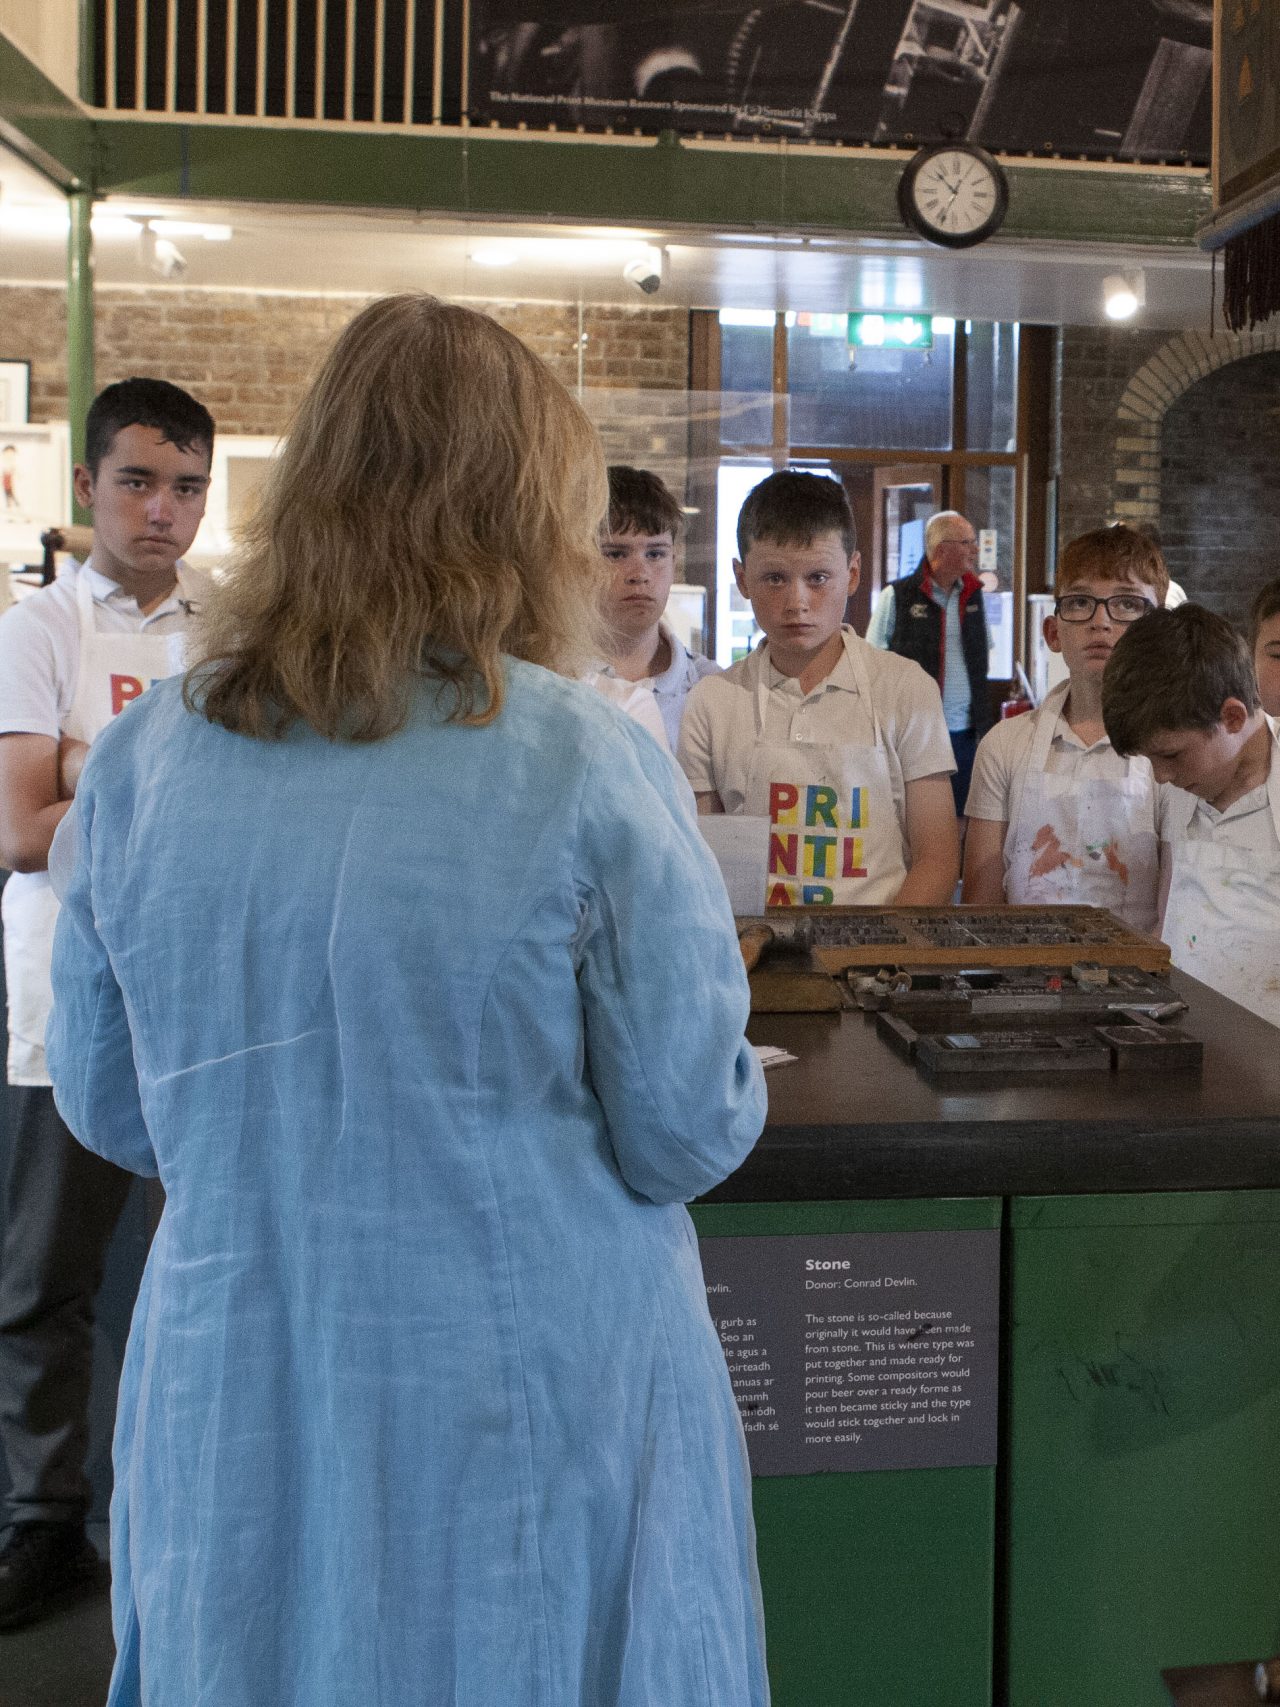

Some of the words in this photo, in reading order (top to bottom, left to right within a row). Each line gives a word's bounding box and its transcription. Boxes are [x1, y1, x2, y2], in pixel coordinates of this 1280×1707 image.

[489, 90, 509, 102] The
[511, 92, 555, 104] National
[557, 94, 582, 105] Print
[583, 96, 628, 108] Museum
[629, 98, 672, 109] Banners
[672, 100, 729, 114] Sponsored
[762, 105, 800, 118] Smurfit
[769, 782, 869, 829] PRI
[768, 832, 868, 878] NTL
[805, 1259, 851, 1271] Stone
[706, 1283, 732, 1293] evlin.
[805, 1280, 841, 1290] Donor:
[844, 1278, 881, 1289] Conrad
[885, 1277, 918, 1287] Devlin.
[806, 1314, 824, 1323] The
[827, 1314, 854, 1323] stone
[858, 1314, 864, 1322] is
[868, 1311, 911, 1321] so-called
[914, 1310, 952, 1319] because
[721, 1317, 744, 1330] gurb
[720, 1332, 740, 1342] Seo
[742, 1334, 754, 1342] an
[805, 1328, 848, 1340] originally
[851, 1328, 858, 1337] it
[862, 1326, 891, 1336] would
[894, 1326, 916, 1335] have
[945, 1323, 971, 1333] made
[805, 1344, 829, 1353] from
[832, 1344, 861, 1352] stone.
[865, 1342, 887, 1351] This
[888, 1341, 896, 1350] is
[898, 1340, 930, 1350] where
[932, 1340, 954, 1350] type
[956, 1340, 974, 1348] was
[737, 1349, 759, 1360] agus
[762, 1348, 767, 1356] a
[729, 1362, 770, 1372] oirteadh
[805, 1360, 822, 1371] put
[824, 1358, 866, 1370] together
[869, 1357, 886, 1366] and
[890, 1356, 916, 1365] made
[919, 1355, 945, 1366] ready
[948, 1354, 963, 1363] for
[733, 1378, 761, 1387] anuas
[764, 1378, 774, 1386] ar
[805, 1374, 844, 1386] printing.
[848, 1372, 875, 1382] Some
[878, 1370, 938, 1381] compositors
[941, 1368, 970, 1377] would
[736, 1392, 769, 1402] anamh
[805, 1390, 829, 1401] pour
[832, 1388, 854, 1398] beer
[857, 1387, 879, 1396] over
[890, 1385, 917, 1396] ready
[920, 1384, 949, 1394] forme
[741, 1406, 776, 1416] amódh
[805, 1405, 812, 1414] it
[815, 1403, 837, 1413] then
[840, 1401, 877, 1412] became
[880, 1400, 908, 1411] sticky
[911, 1399, 928, 1409] and
[931, 1398, 948, 1408] the
[950, 1398, 971, 1409] type
[744, 1422, 766, 1431] fadh
[768, 1420, 780, 1430] sé
[805, 1419, 835, 1428] would
[838, 1417, 860, 1427] stick
[863, 1415, 905, 1427] together
[907, 1414, 925, 1423] and
[928, 1413, 948, 1422] lock
[951, 1413, 959, 1421] in
[805, 1435, 831, 1443] more
[834, 1432, 863, 1443] easily.
